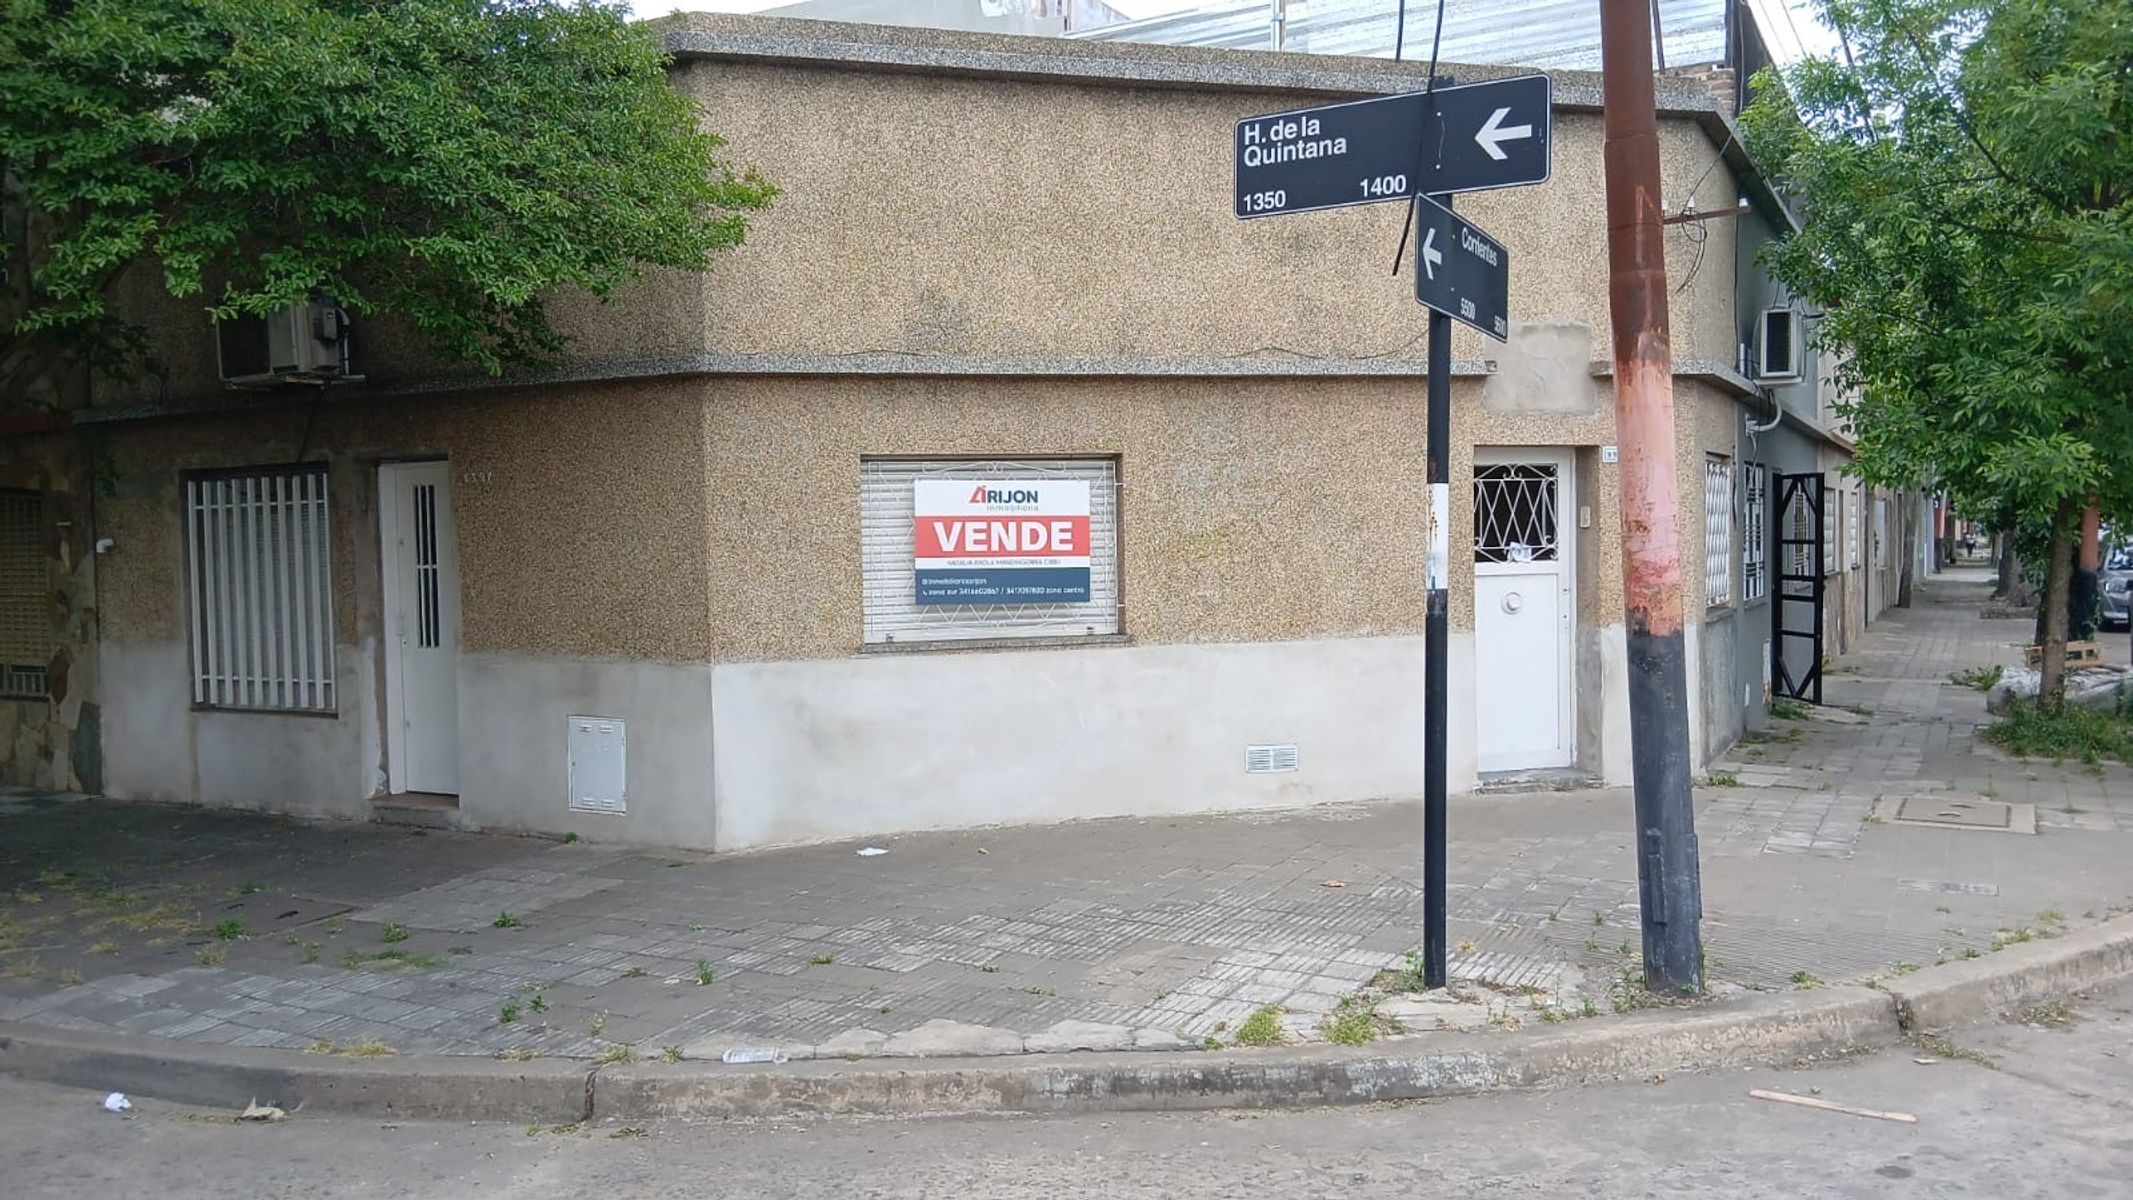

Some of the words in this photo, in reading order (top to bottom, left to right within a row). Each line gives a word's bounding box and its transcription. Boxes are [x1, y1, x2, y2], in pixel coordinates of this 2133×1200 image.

[1243, 124, 1266, 146] H.
[1269, 119, 1299, 140] de
[1300, 116, 1321, 137] la
[1243, 136, 1347, 168] Quintana
[1243, 190, 1286, 212] 1350
[1359, 174, 1407, 197] 1400
[1461, 226, 1498, 267] Corrientes
[970, 485, 1038, 504] ARIJON
[933, 521, 1074, 552] VENDE
